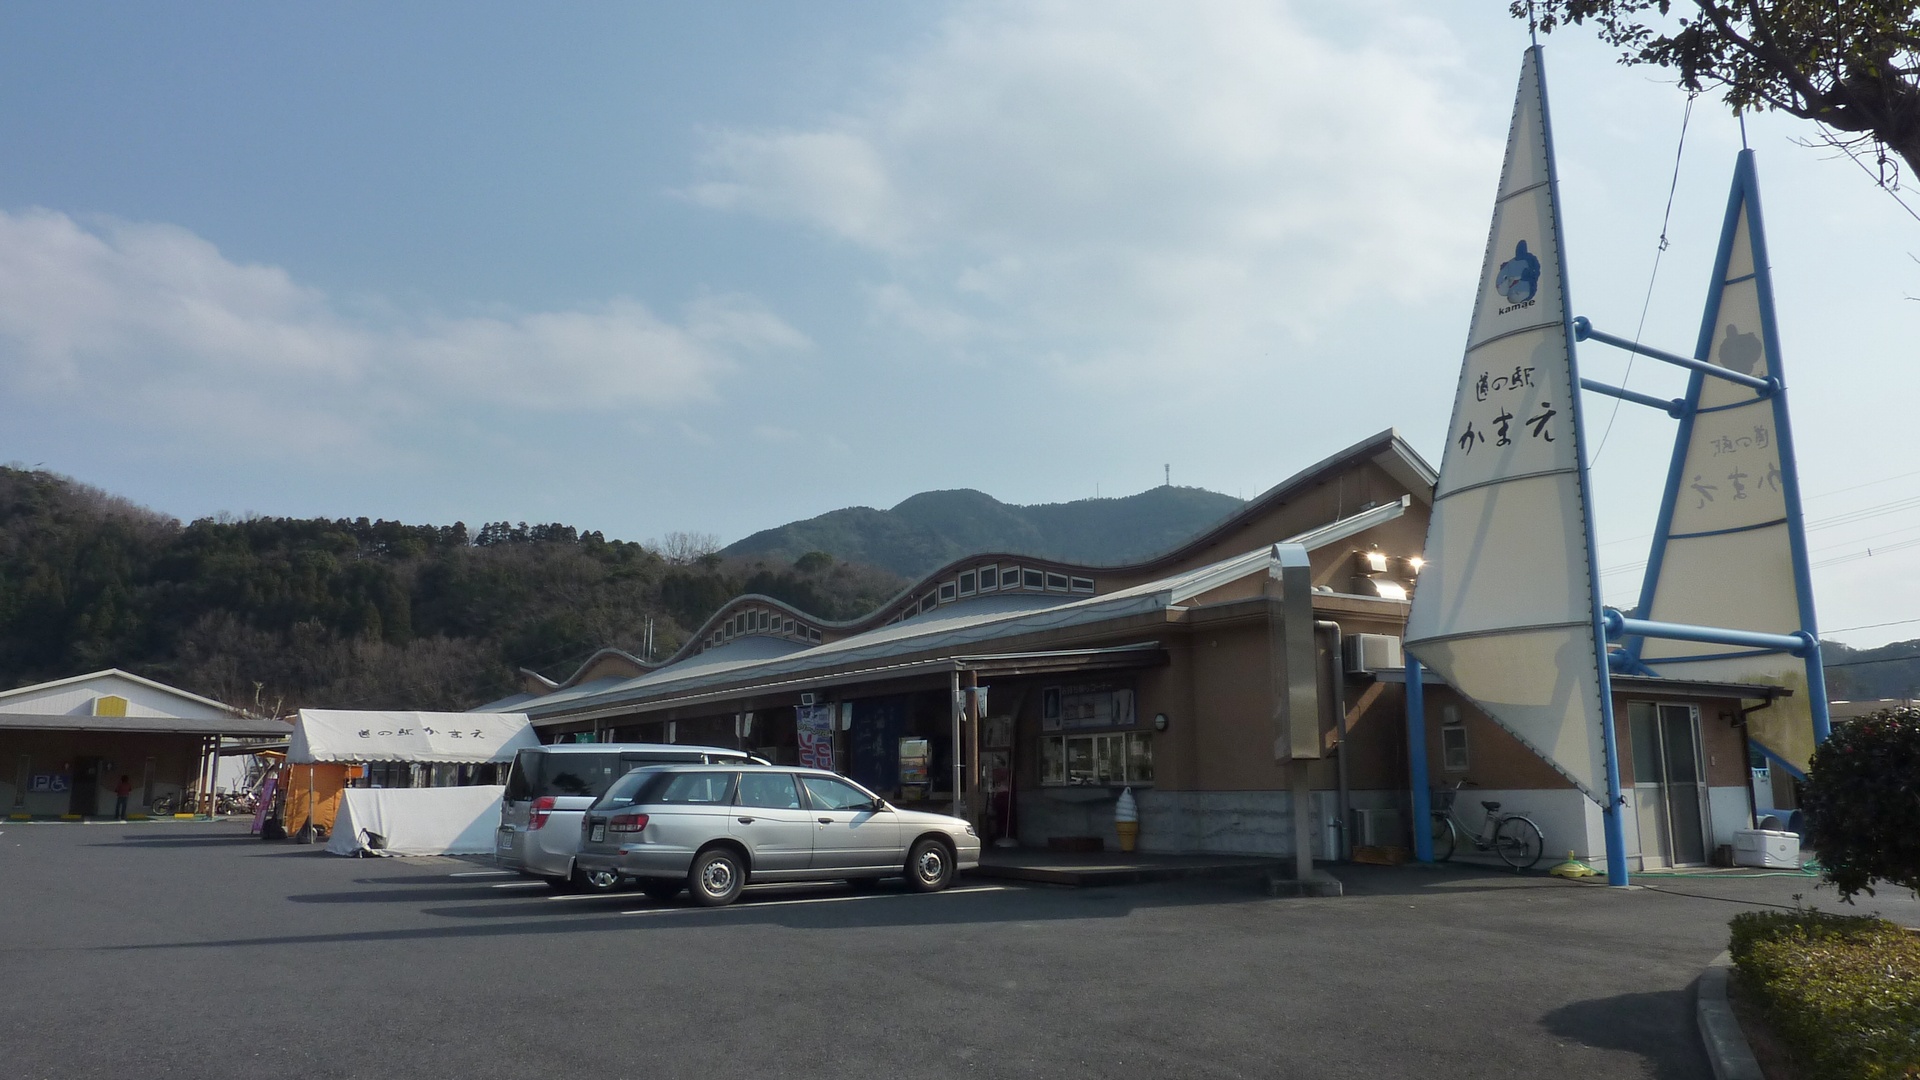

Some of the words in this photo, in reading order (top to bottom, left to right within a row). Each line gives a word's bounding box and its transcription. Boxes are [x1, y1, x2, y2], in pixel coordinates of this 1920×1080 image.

[1498, 299, 1536, 316] kamae
[1476, 365, 1536, 402] 道の駅
[1458, 402, 1557, 456] かまえ
